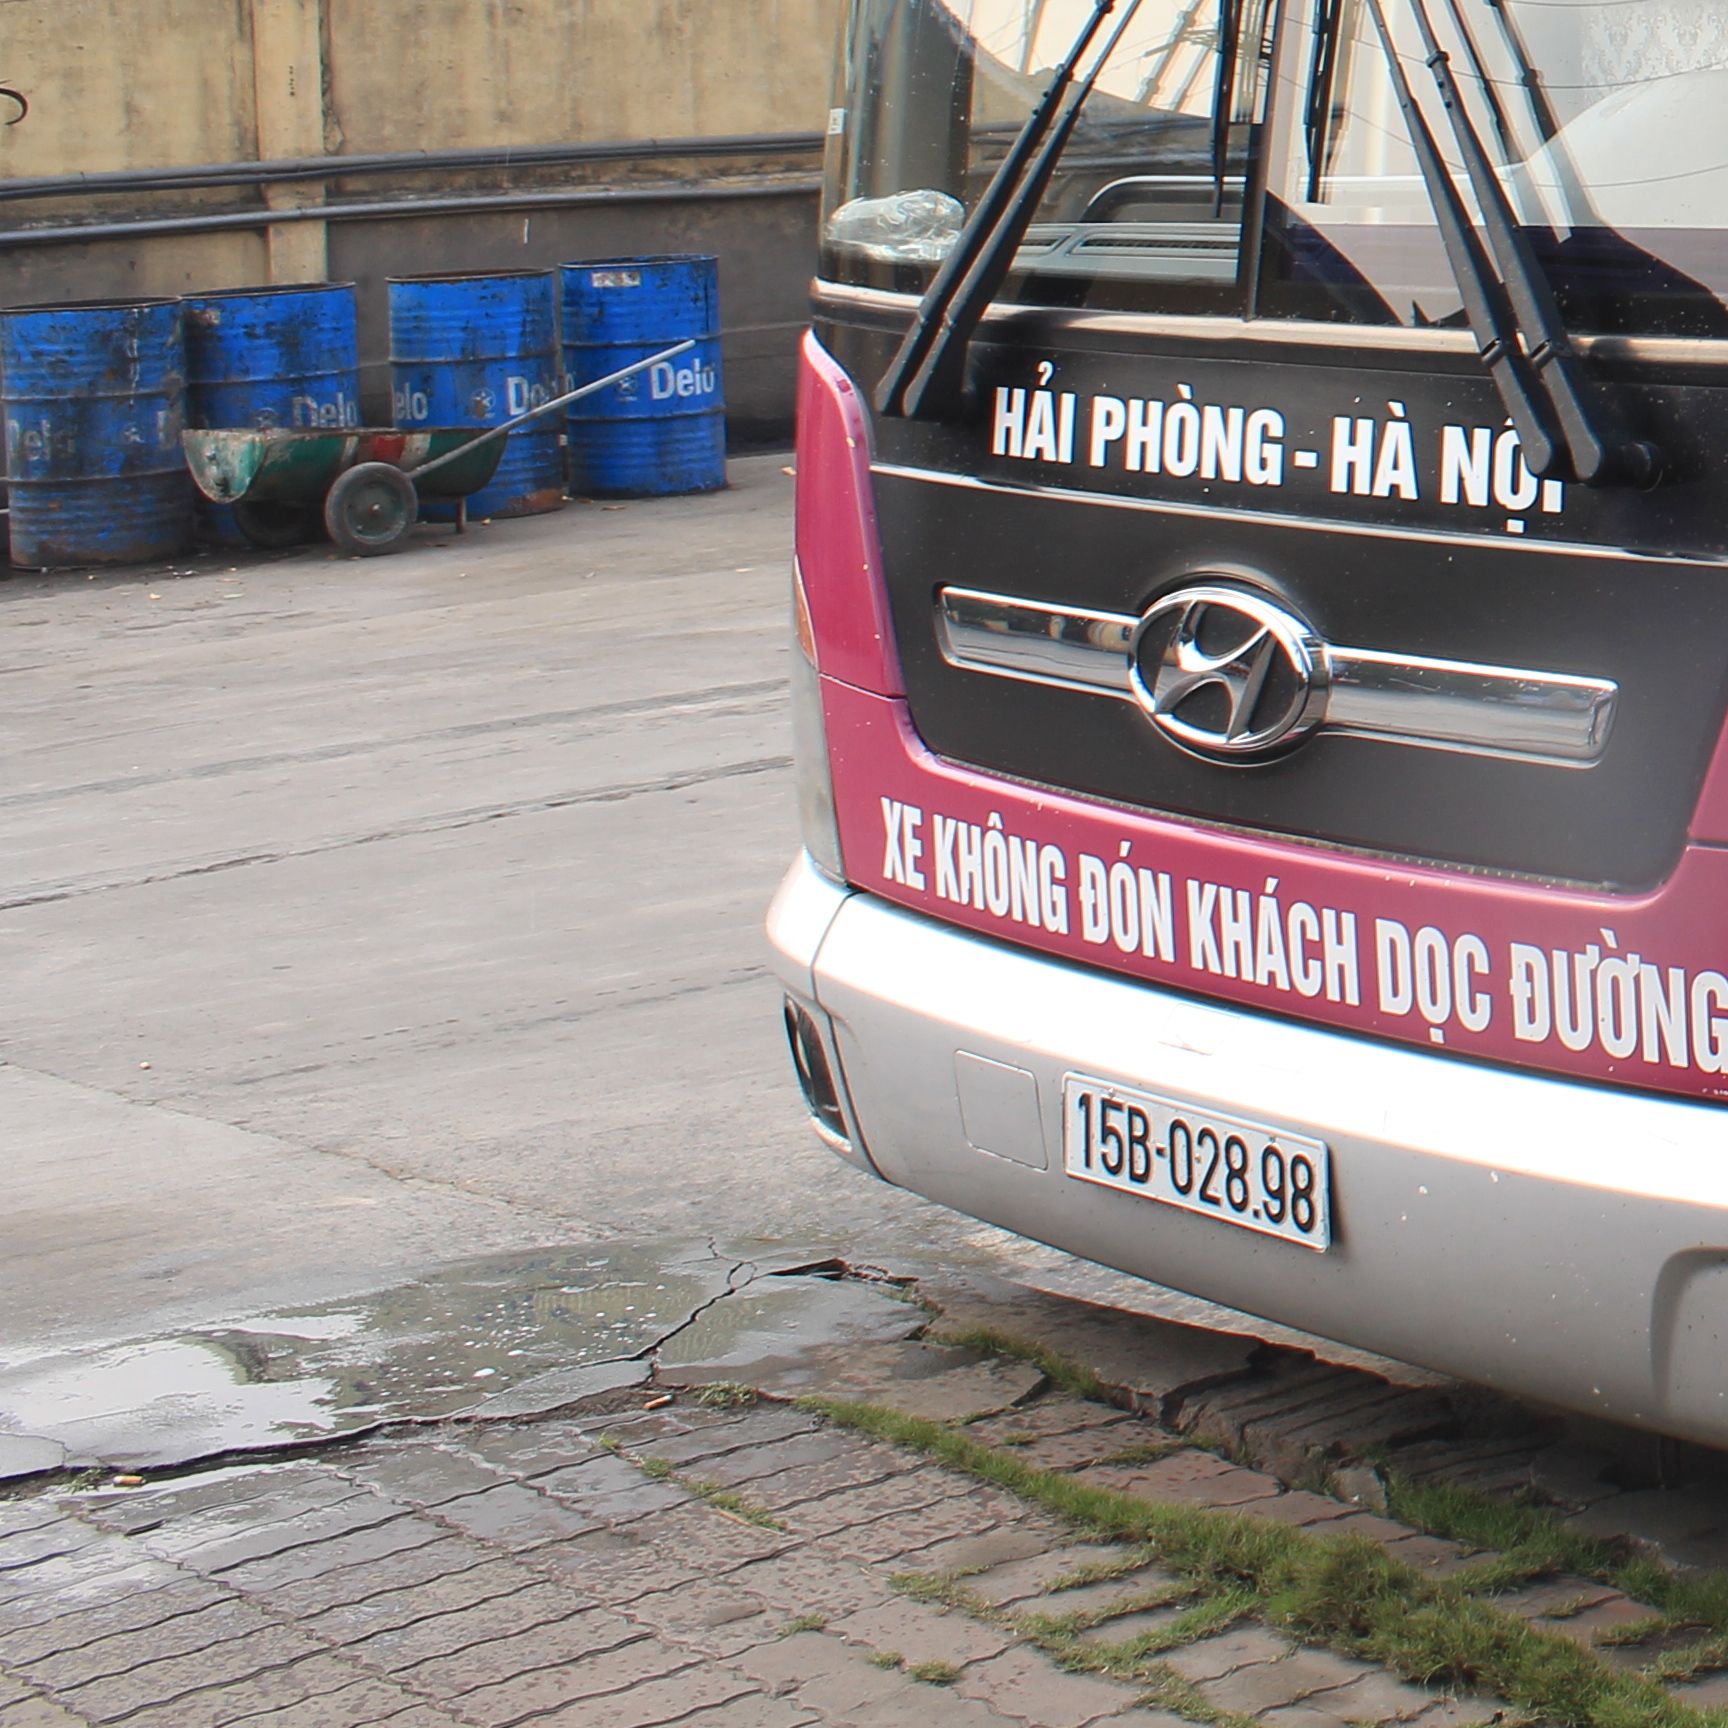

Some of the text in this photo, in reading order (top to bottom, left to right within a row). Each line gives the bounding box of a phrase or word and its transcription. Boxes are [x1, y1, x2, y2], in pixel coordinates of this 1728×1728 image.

[651, 358, 715, 401] Delo
[992, 361, 1075, 465] HẢI
[1091, 384, 1285, 486] PHÒNG
[1329, 400, 1419, 501] HÀ
[881, 796, 924, 892] XE
[933, 813, 1070, 935] KHÔNG
[1079, 839, 1175, 962] ĐÓN
[1186, 877, 1360, 1005] KHÁCH
[1375, 917, 1492, 1044] DỌC
[1078, 1090, 1316, 1233] 15B-028.98
